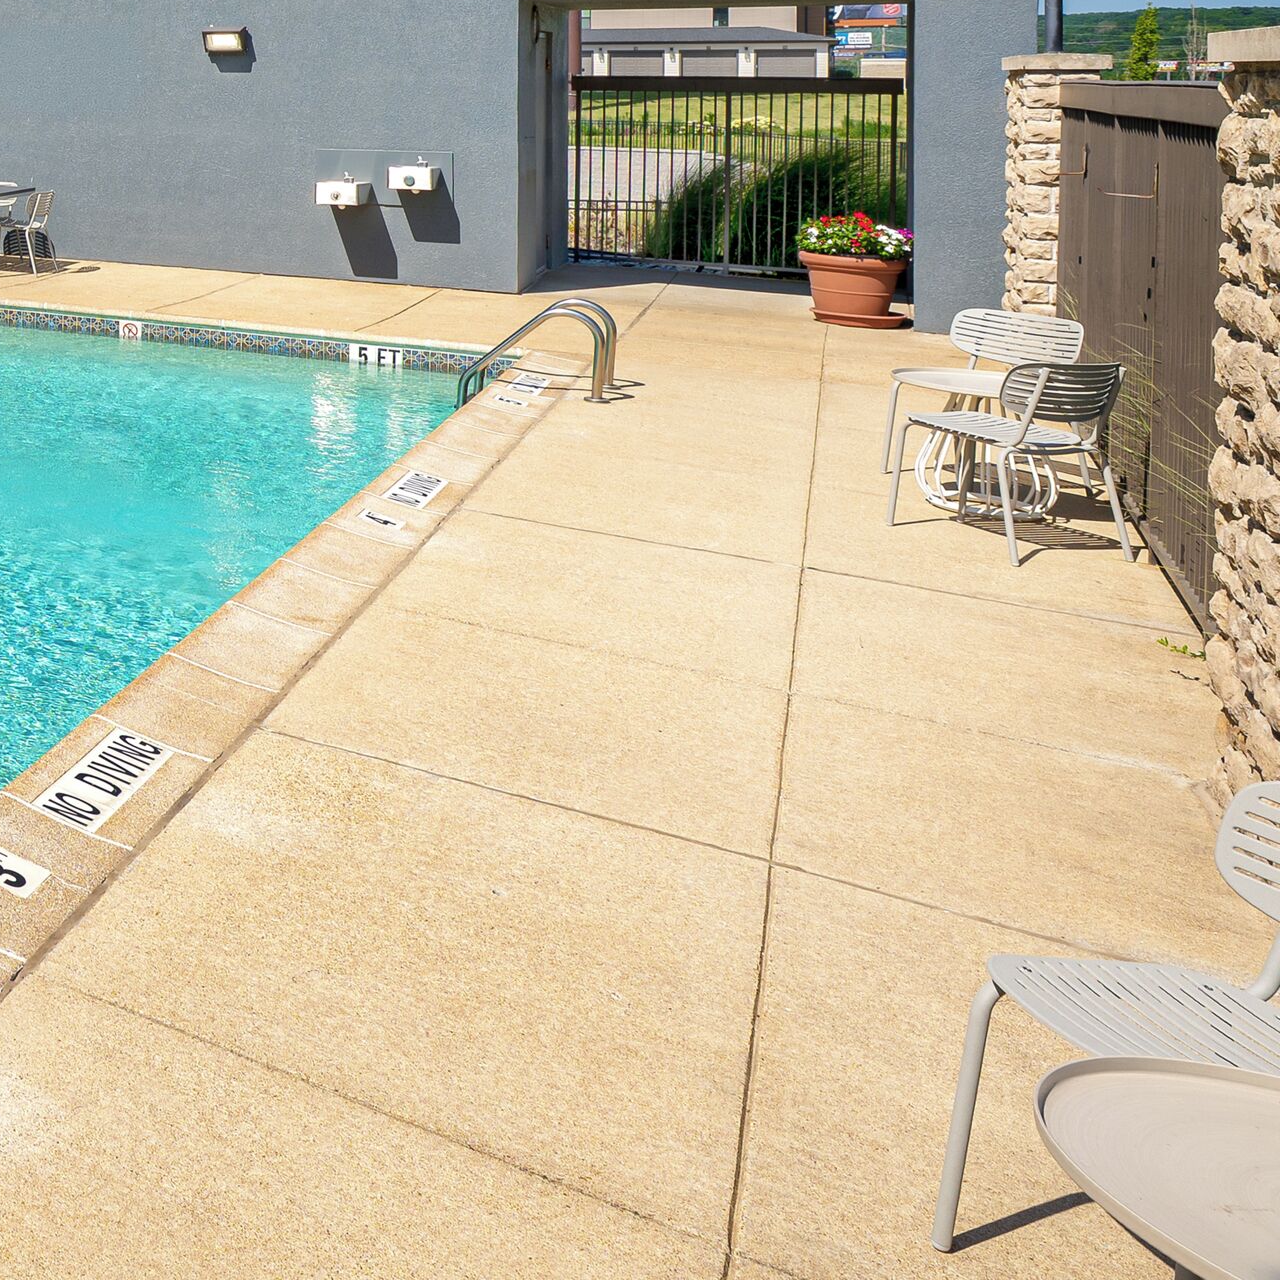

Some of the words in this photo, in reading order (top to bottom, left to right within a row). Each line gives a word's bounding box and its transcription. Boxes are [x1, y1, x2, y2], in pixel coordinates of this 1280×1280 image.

[358, 346, 368, 365] 5
[377, 347, 401, 369] FT
[42, 791, 102, 828] NO
[74, 733, 165, 798] DIVING
